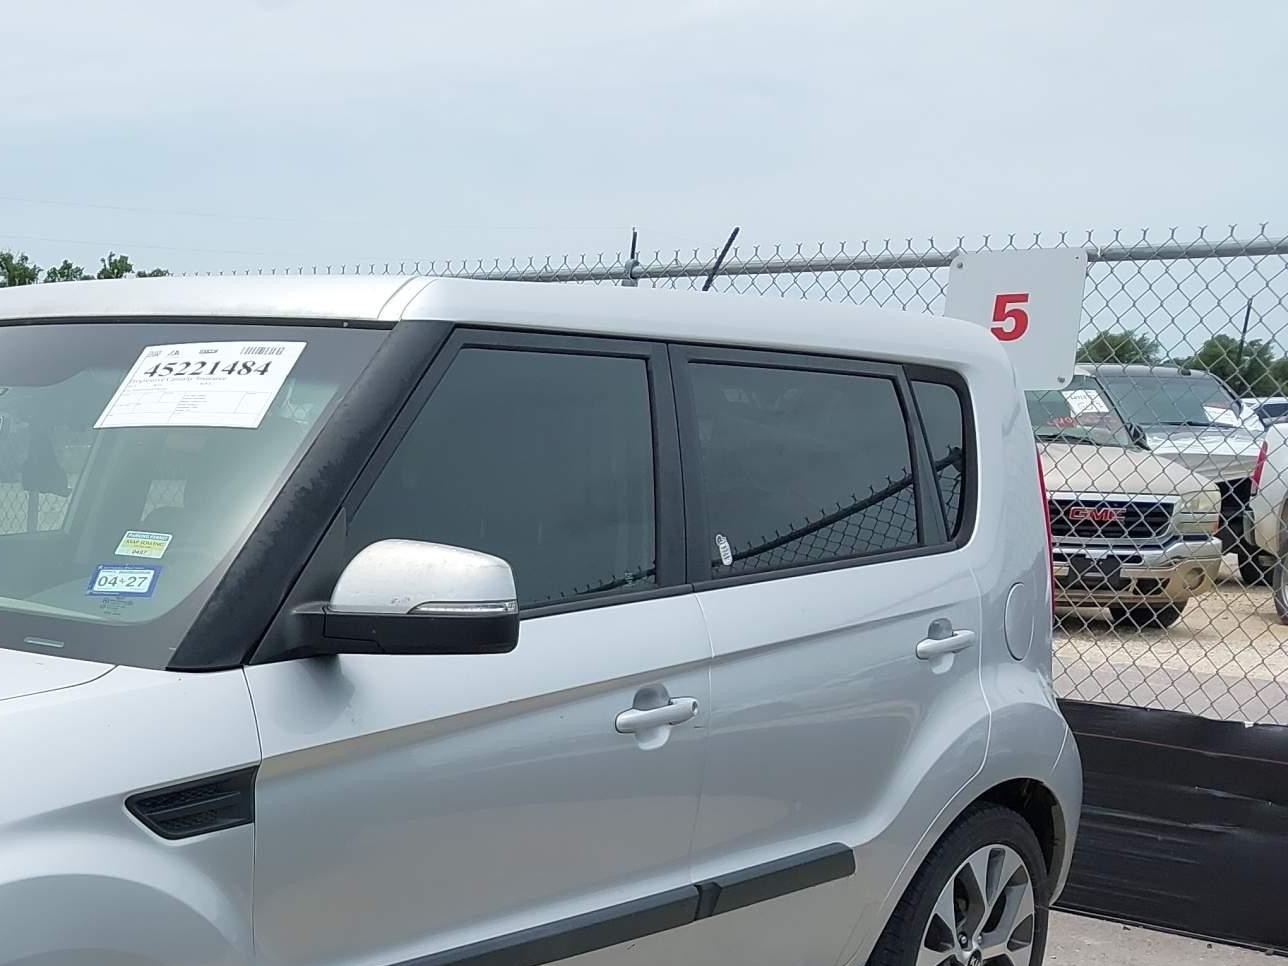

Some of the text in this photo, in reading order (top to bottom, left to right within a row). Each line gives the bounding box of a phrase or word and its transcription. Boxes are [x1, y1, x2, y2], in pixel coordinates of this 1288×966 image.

[990, 293, 1029, 342] 5
[144, 360, 271, 377] 45221484
[1069, 506, 1127, 521] GMC
[97, 575, 148, 588] 04 27
